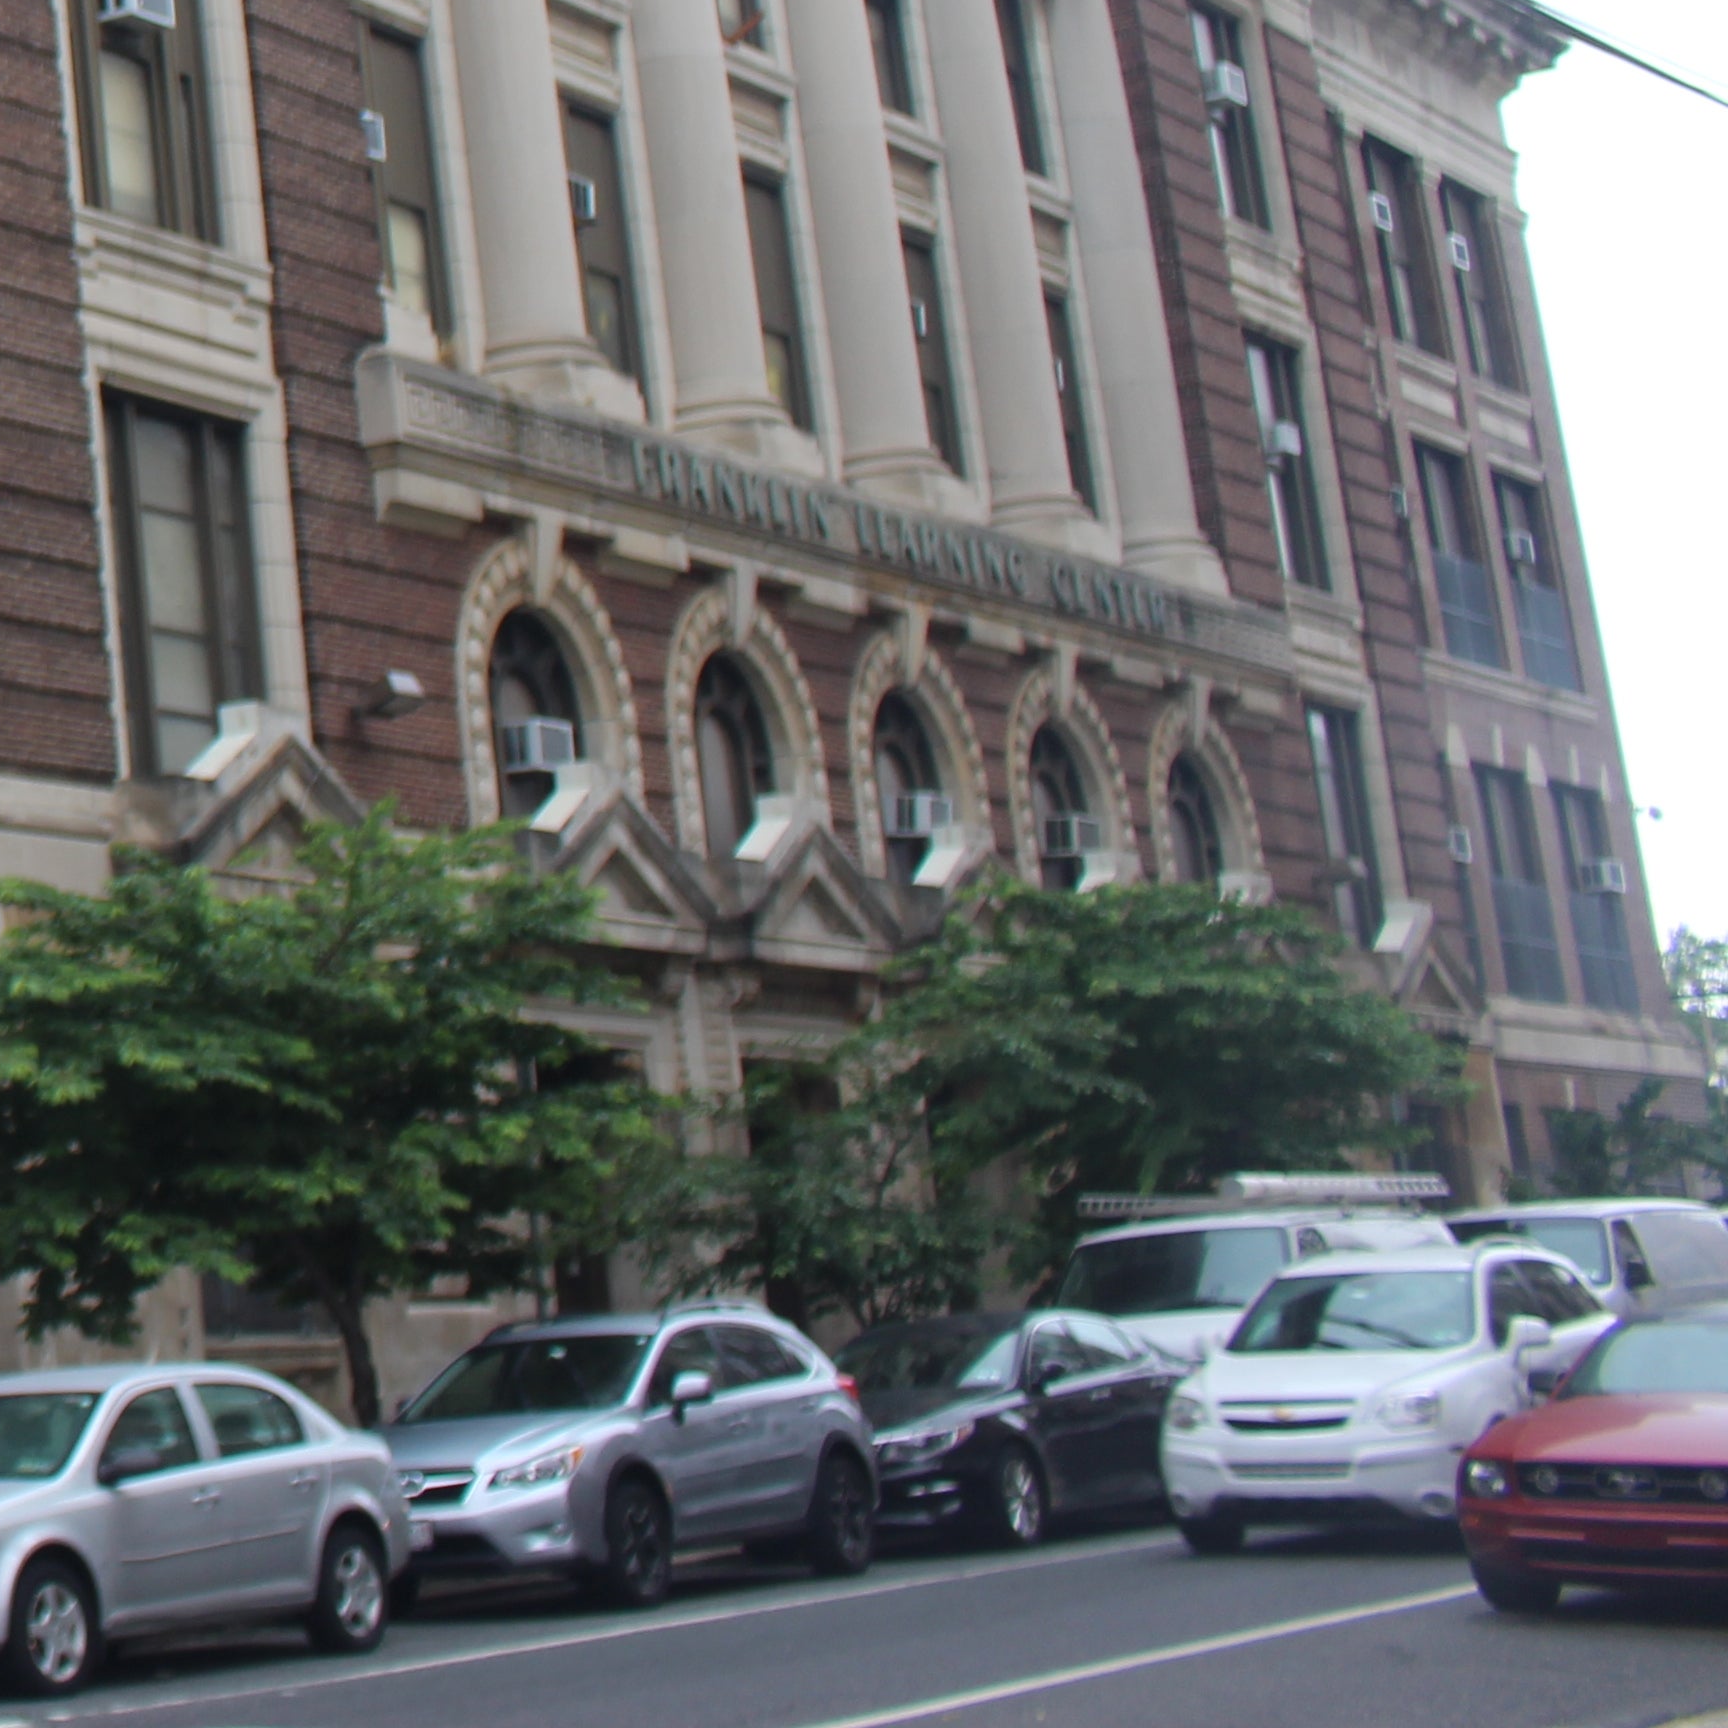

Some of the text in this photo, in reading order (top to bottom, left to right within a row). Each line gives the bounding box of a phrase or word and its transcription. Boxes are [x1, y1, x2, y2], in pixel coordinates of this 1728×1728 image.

[631, 436, 1168, 636] FRANKLIN LEARNING CENTER
